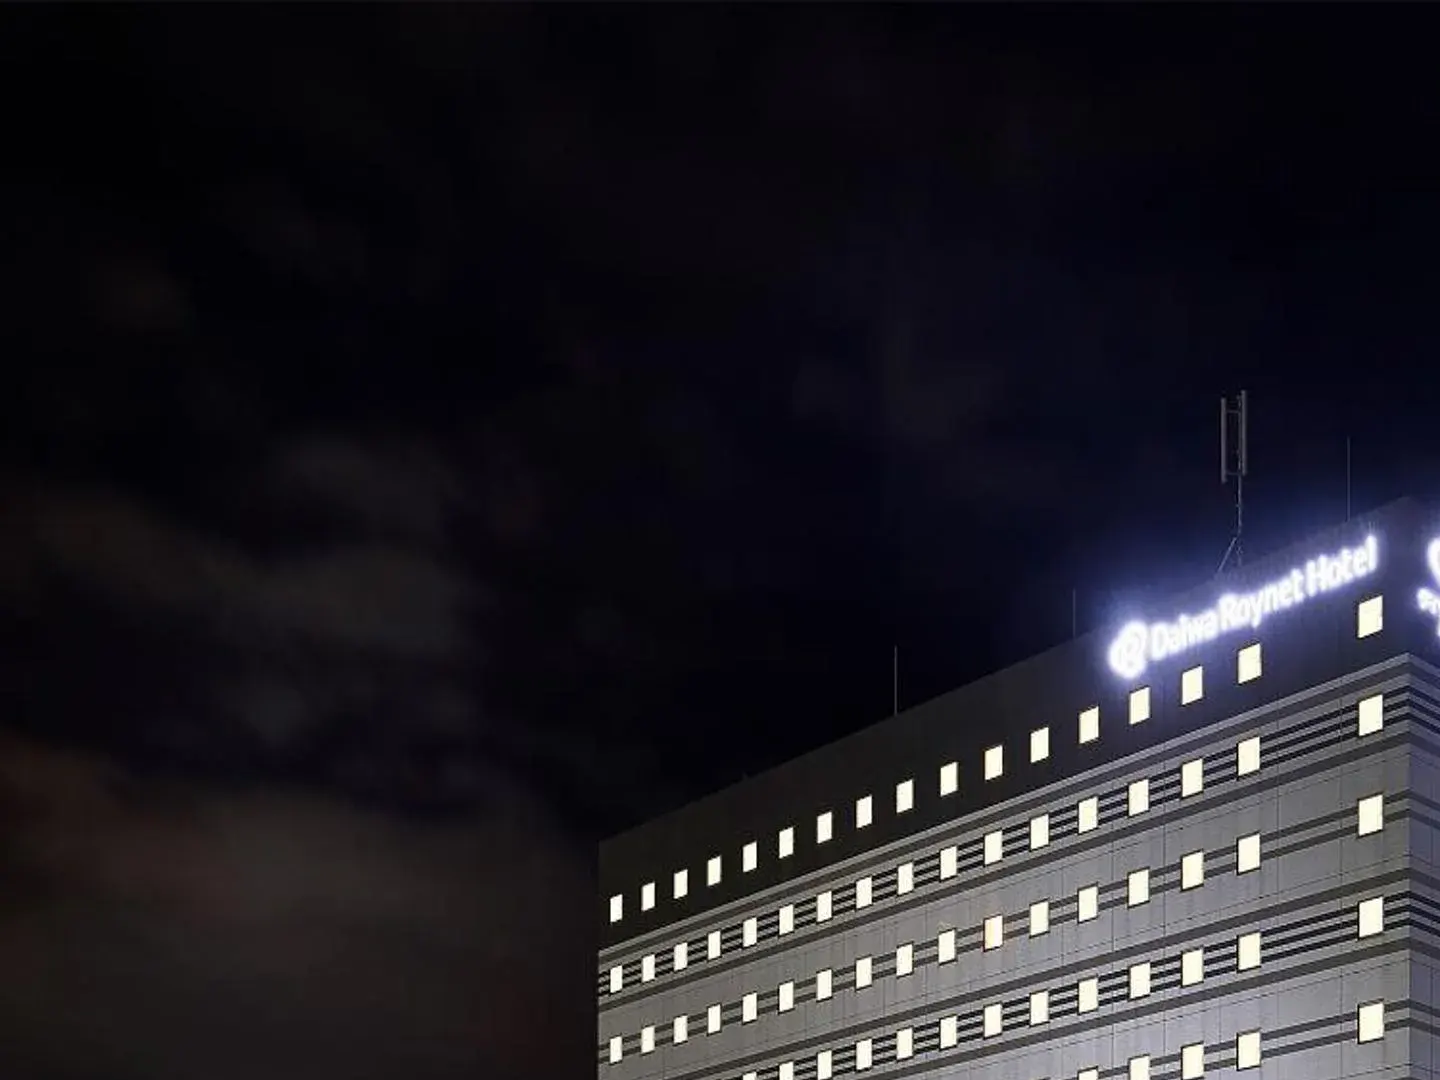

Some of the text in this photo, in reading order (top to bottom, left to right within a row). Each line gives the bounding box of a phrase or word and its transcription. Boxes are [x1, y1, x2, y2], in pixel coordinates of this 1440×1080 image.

[1150, 534, 1377, 660] Daiwa Roynet Hotel
